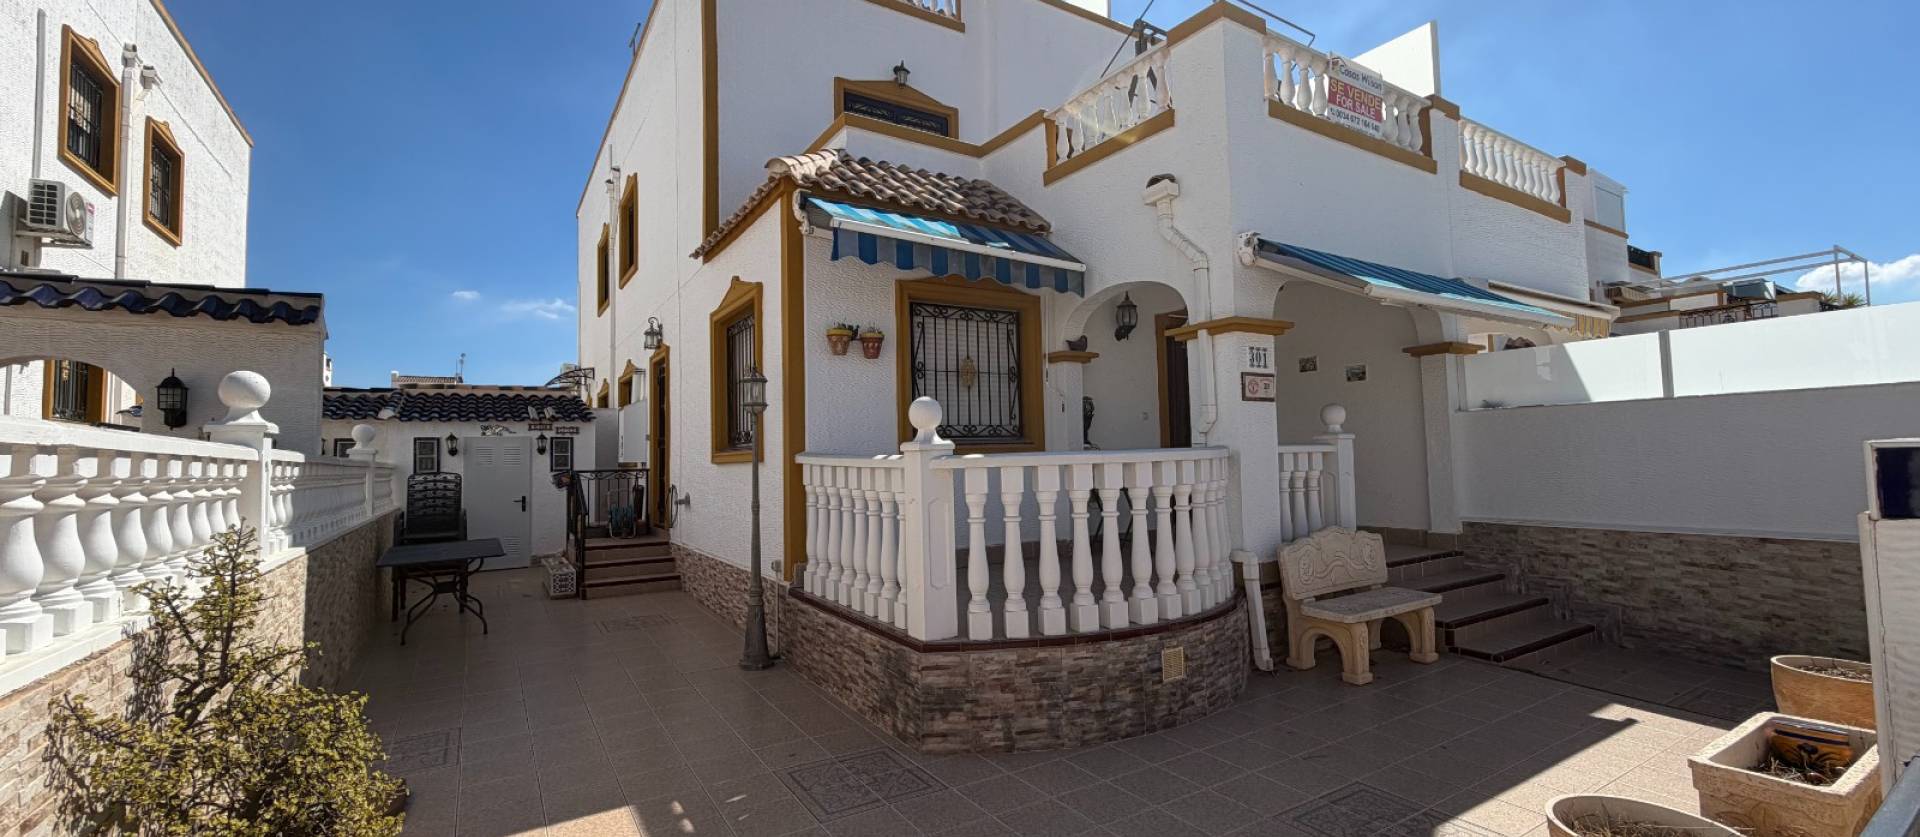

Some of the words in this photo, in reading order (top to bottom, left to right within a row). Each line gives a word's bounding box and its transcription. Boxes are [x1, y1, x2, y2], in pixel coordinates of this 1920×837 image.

[1330, 79, 1345, 95] SE
[1347, 85, 1383, 111] VENDE
[1336, 94, 1353, 111] FOR
[1355, 101, 1376, 121] SALE
[1248, 346, 1268, 369] 301
